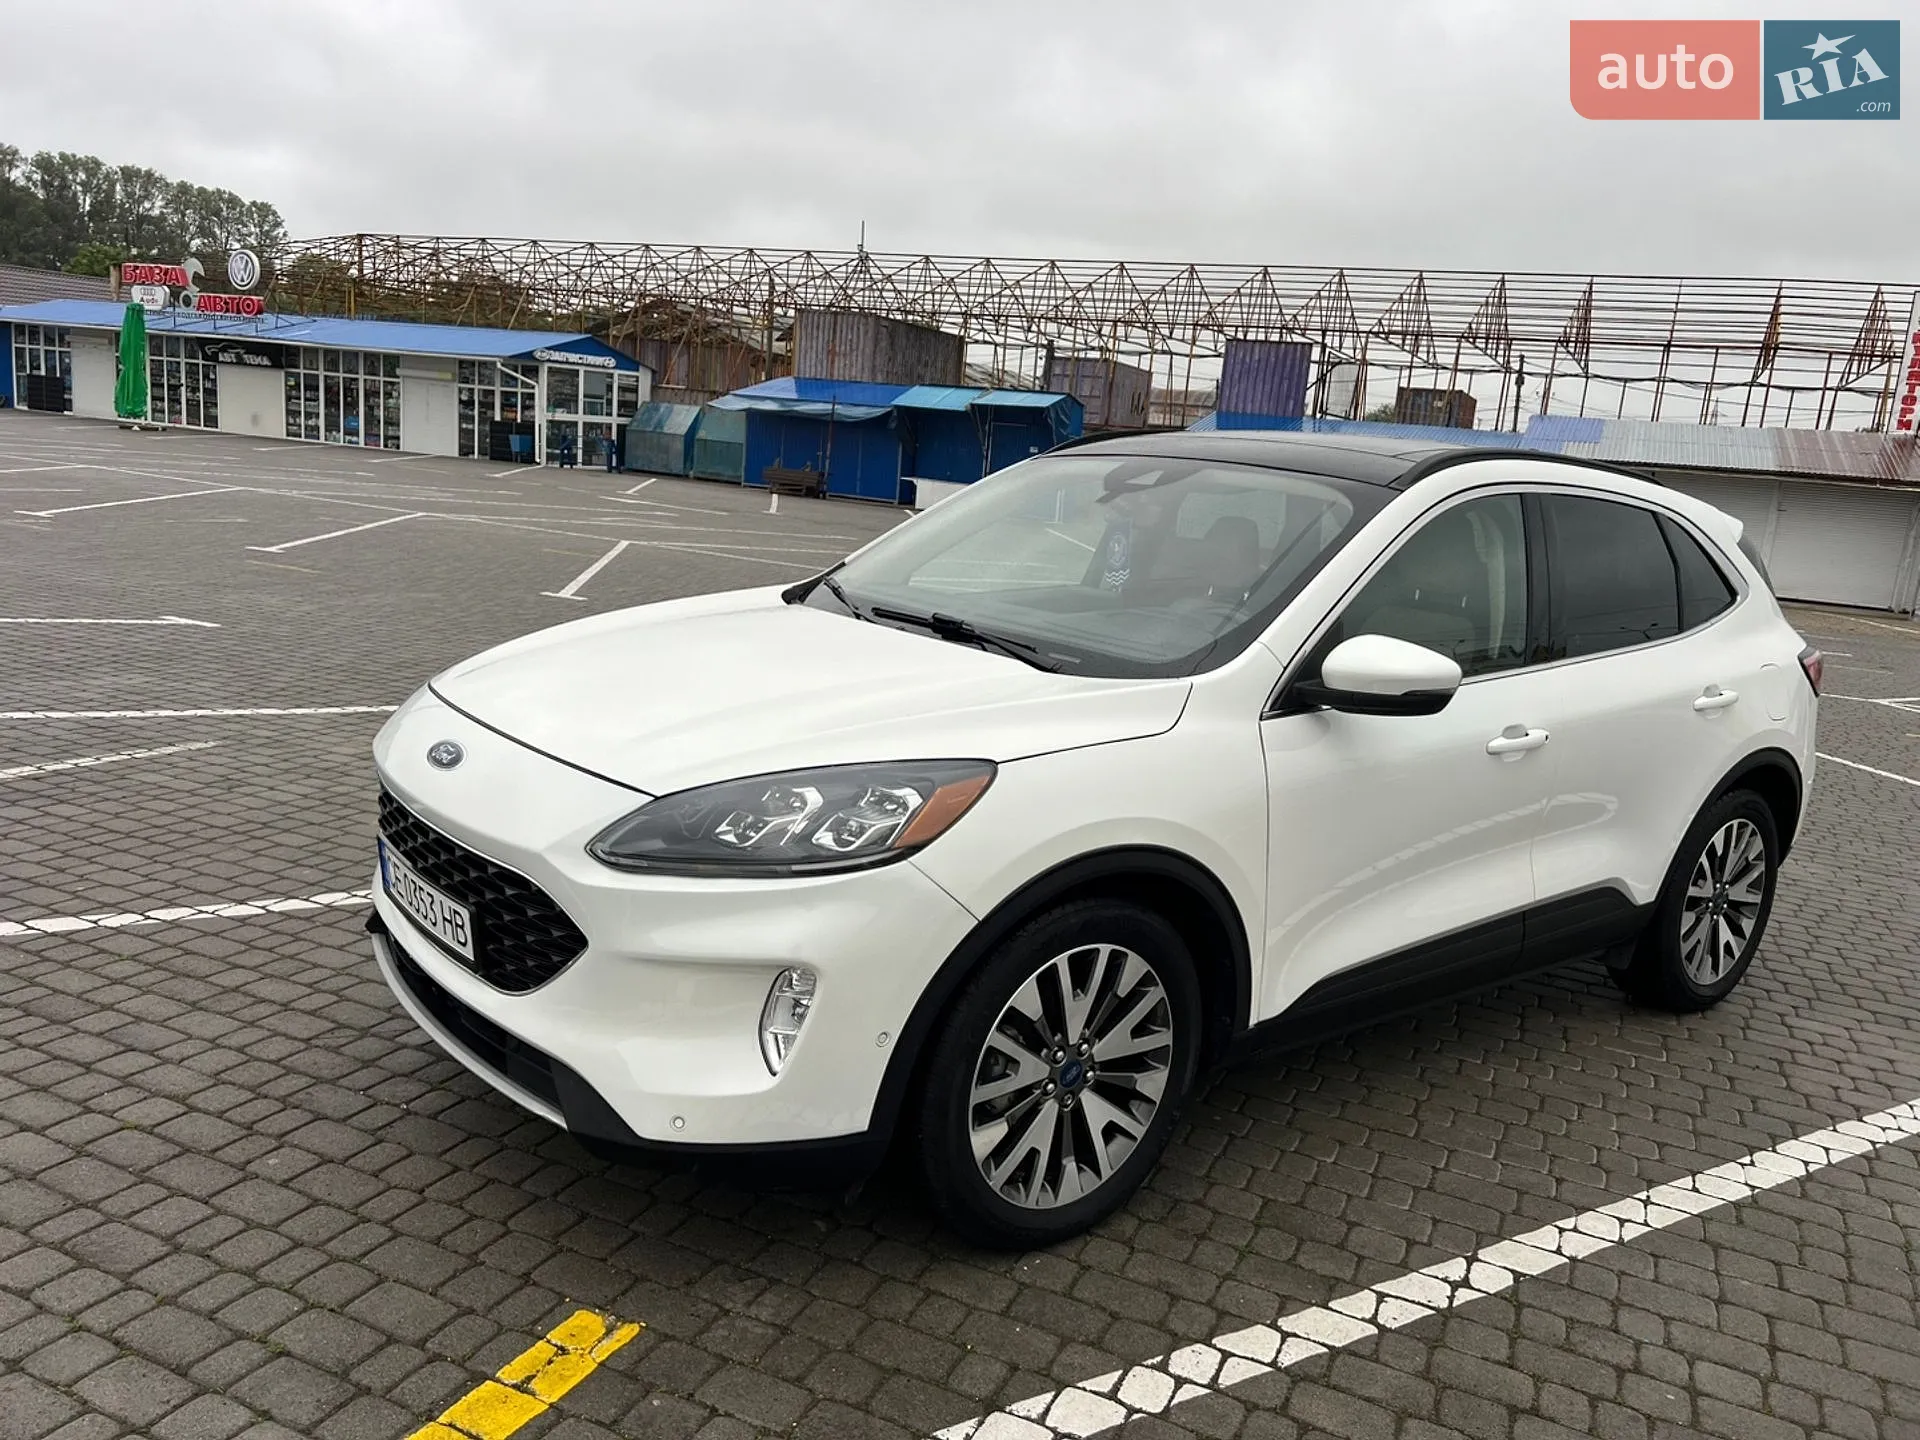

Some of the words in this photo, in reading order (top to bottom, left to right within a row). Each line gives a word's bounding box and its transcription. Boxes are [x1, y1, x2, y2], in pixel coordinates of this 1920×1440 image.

[122, 264, 183, 287] БАЗА
[196, 295, 259, 317] АВТО
[404, 872, 437, 927] 0353
[440, 900, 468, 948] HB
